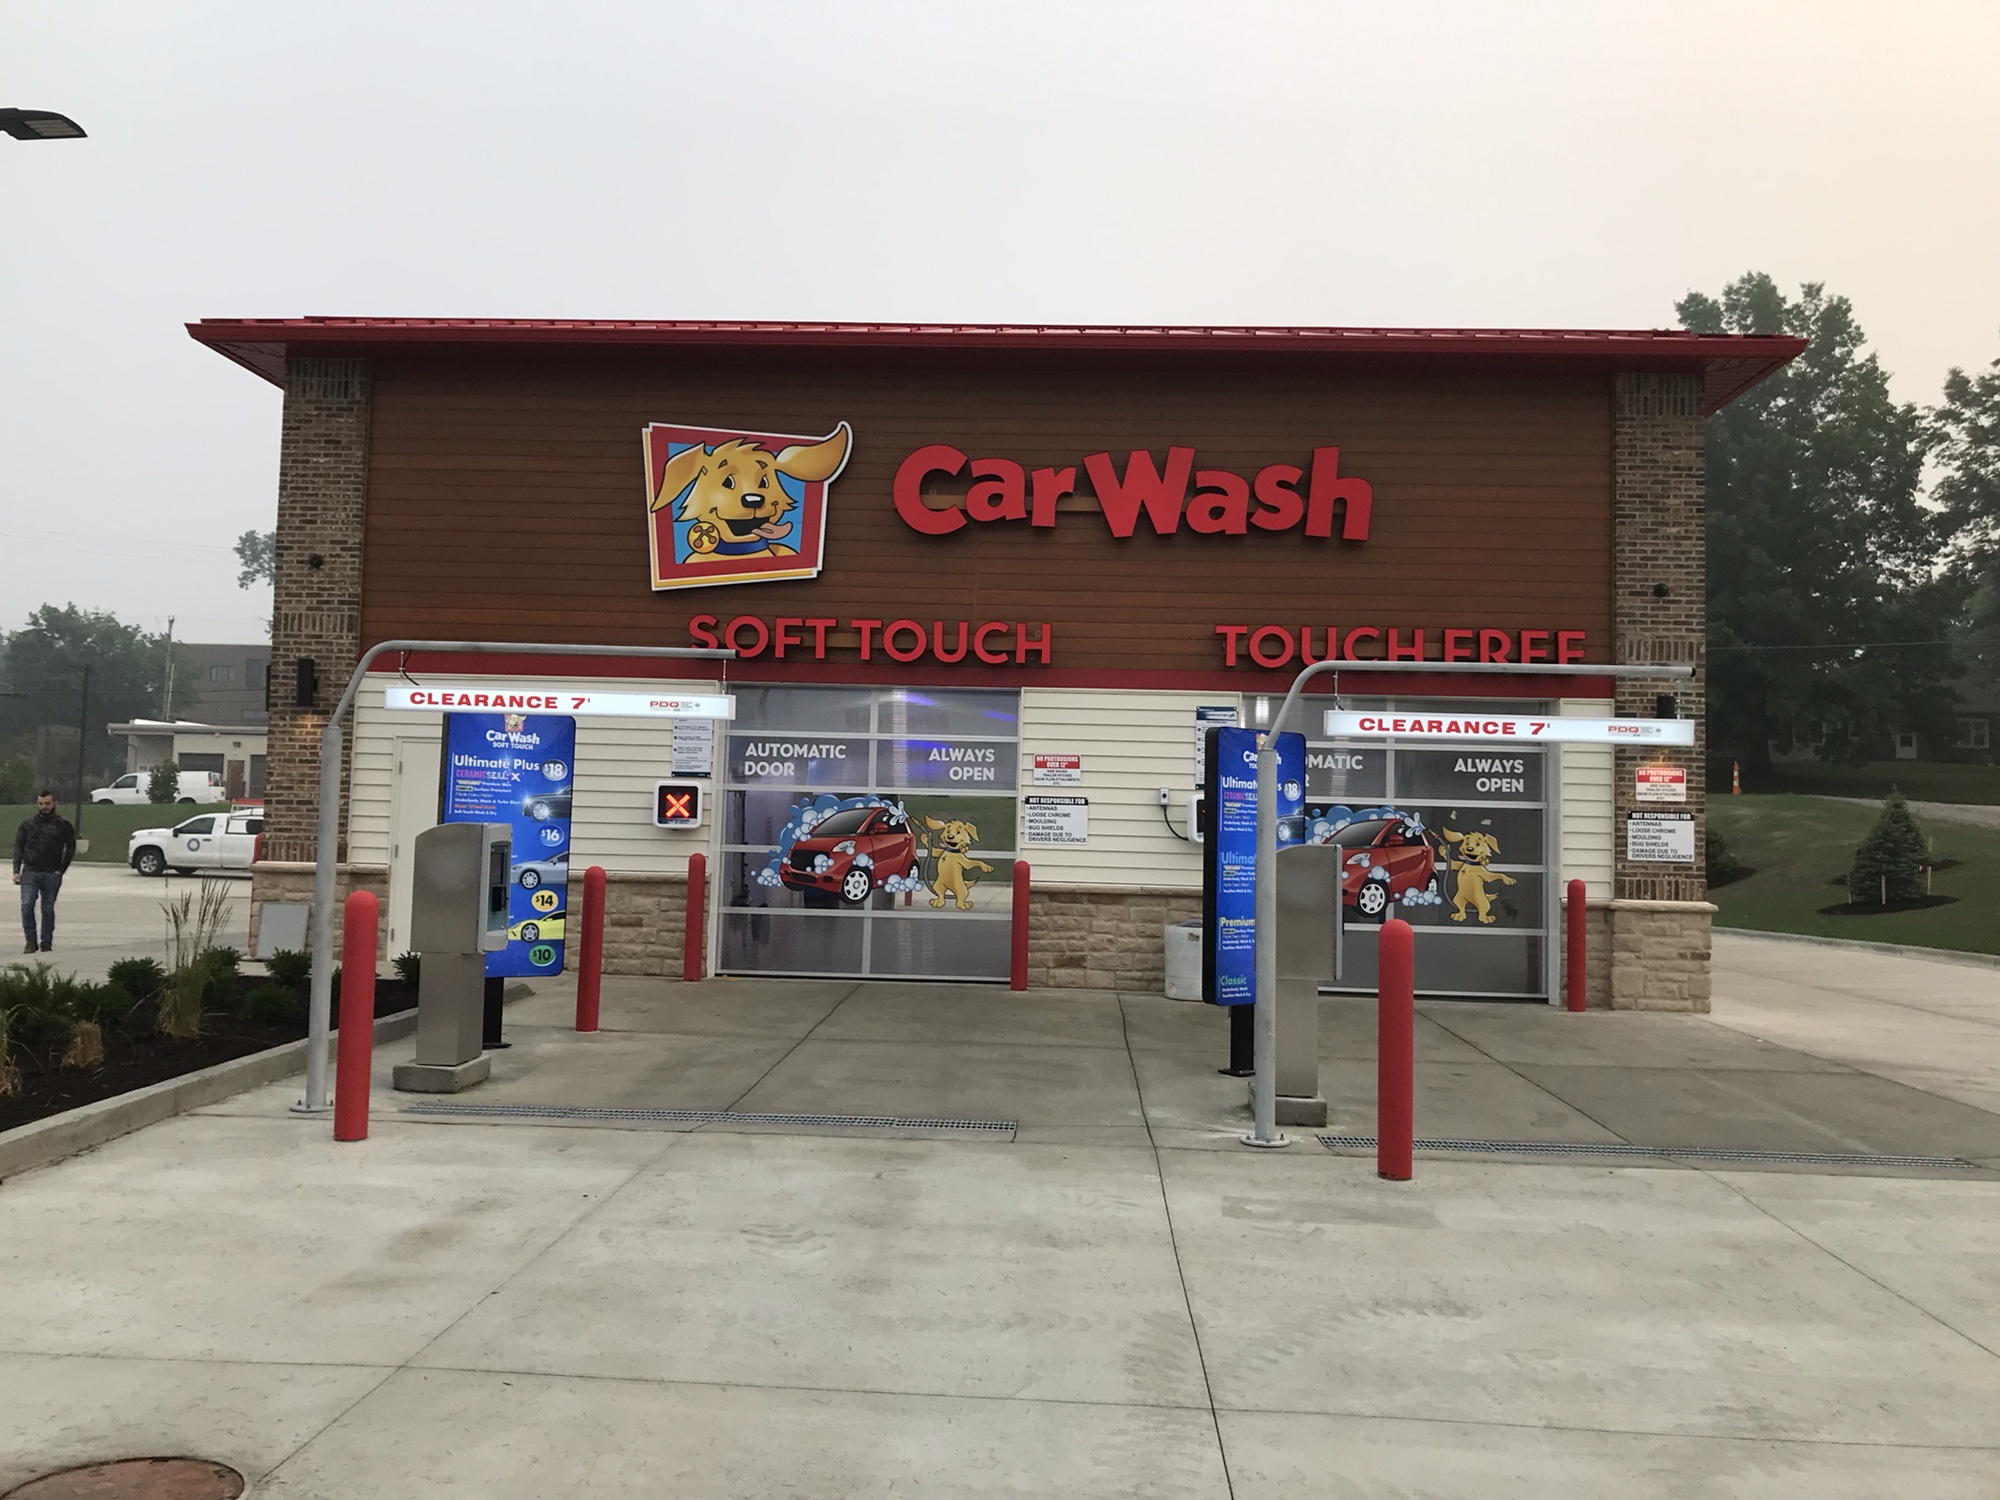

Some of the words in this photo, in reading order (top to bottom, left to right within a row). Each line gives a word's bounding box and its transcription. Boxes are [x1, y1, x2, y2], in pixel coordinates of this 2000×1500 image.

[688, 614, 837, 659] SOFT
[851, 619, 1052, 664] TOUCH
[1215, 625, 1426, 668] TOUCH
[409, 692, 558, 709] CLEARANCE
[571, 697, 591, 709] 7'
[649, 700, 680, 708] PDQ
[1358, 717, 1516, 735] CLEARANCE
[1529, 722, 1551, 735] 7'
[1608, 725, 1639, 733] PDQ
[511, 742, 534, 750] TOUCH
[745, 743, 847, 759] AUTOMATIC
[928, 748, 995, 762] ALWAYS
[454, 755, 510, 769] Ultimate
[514, 758, 540, 771] Plus
[543, 763, 564, 777] $18
[744, 761, 795, 776] DOOR
[949, 766, 995, 781] OPEN
[1306, 755, 1363, 770] MATIC
[1453, 758, 1524, 774] ALWAYS
[1222, 776, 1258, 790] Ultimat
[1284, 783, 1298, 797] $18
[1475, 778, 1524, 793] OPEN
[541, 829, 560, 841] $16
[535, 895, 553, 907] $14
[533, 949, 551, 961] $10
[1220, 974, 1247, 986] Classic
